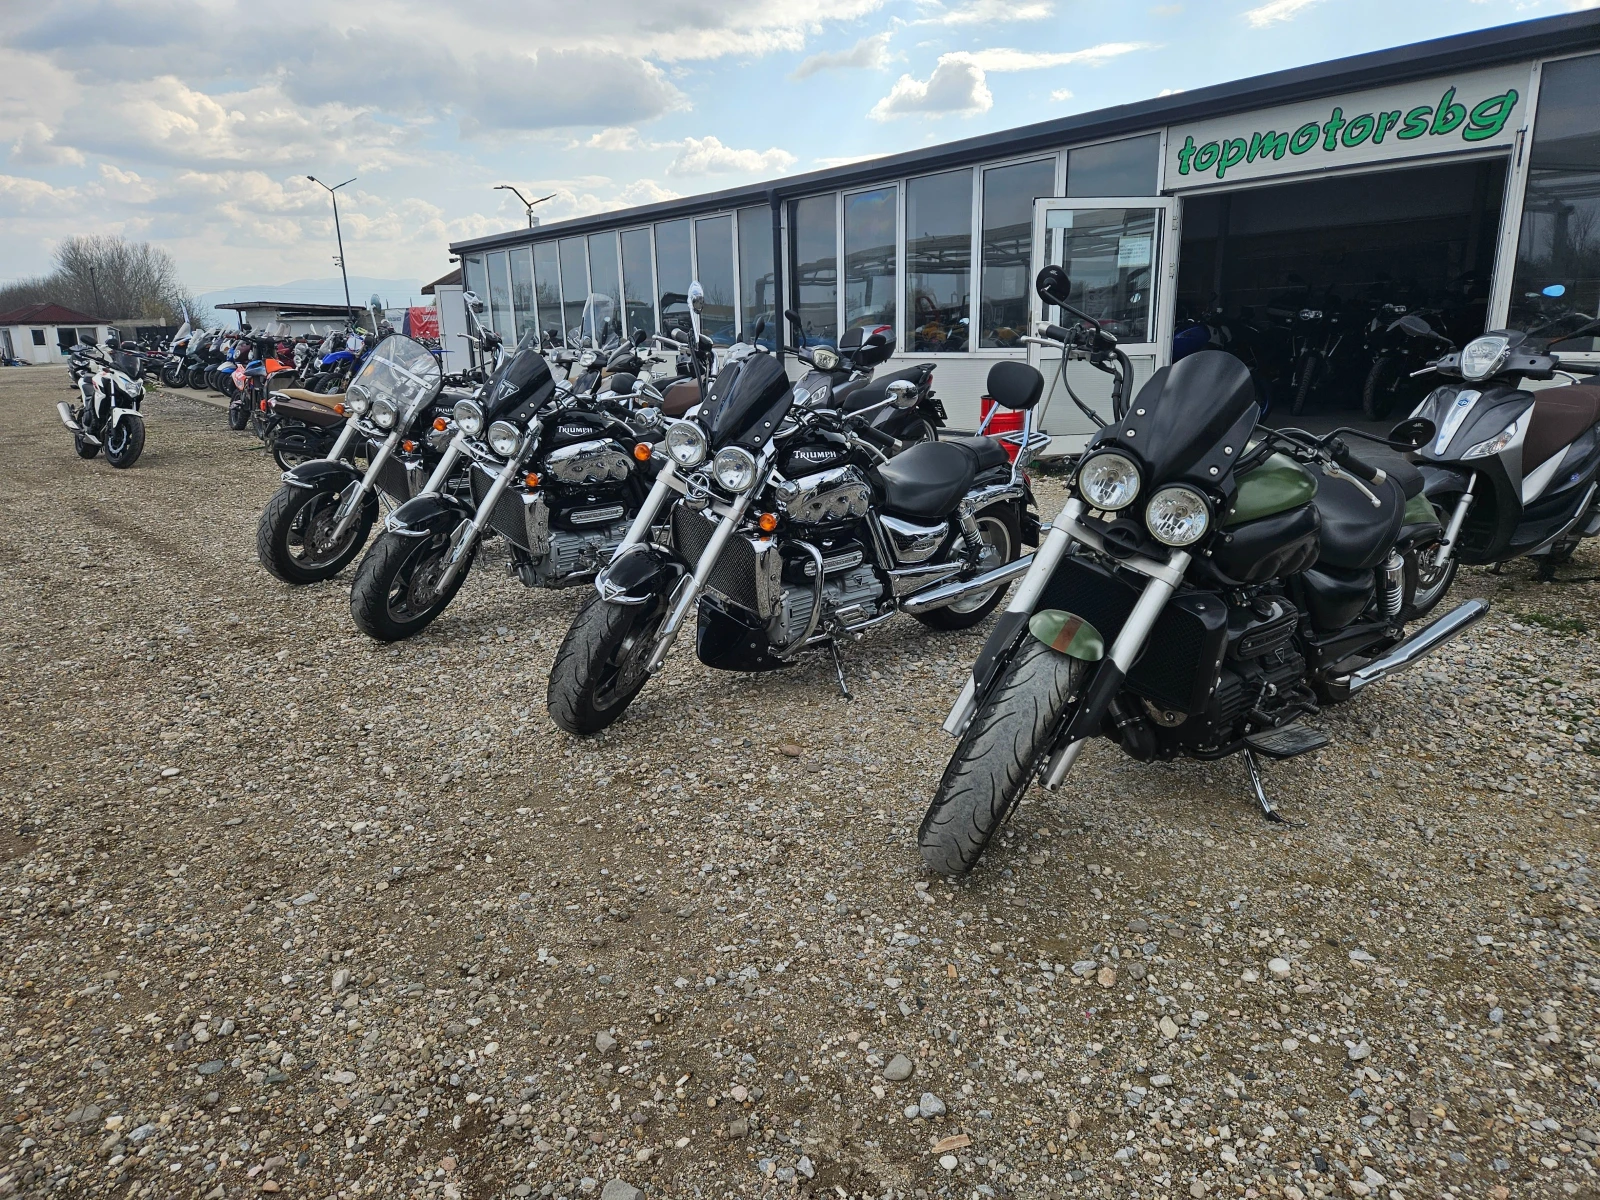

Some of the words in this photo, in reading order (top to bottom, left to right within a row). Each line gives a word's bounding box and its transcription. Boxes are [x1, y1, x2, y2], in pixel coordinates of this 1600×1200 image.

[1178, 86, 1519, 179] topmotorsbg
[434, 406, 455, 415] TRIUM
[557, 425, 593, 436] TRIUMPH
[793, 450, 837, 462] TRIUMPH
